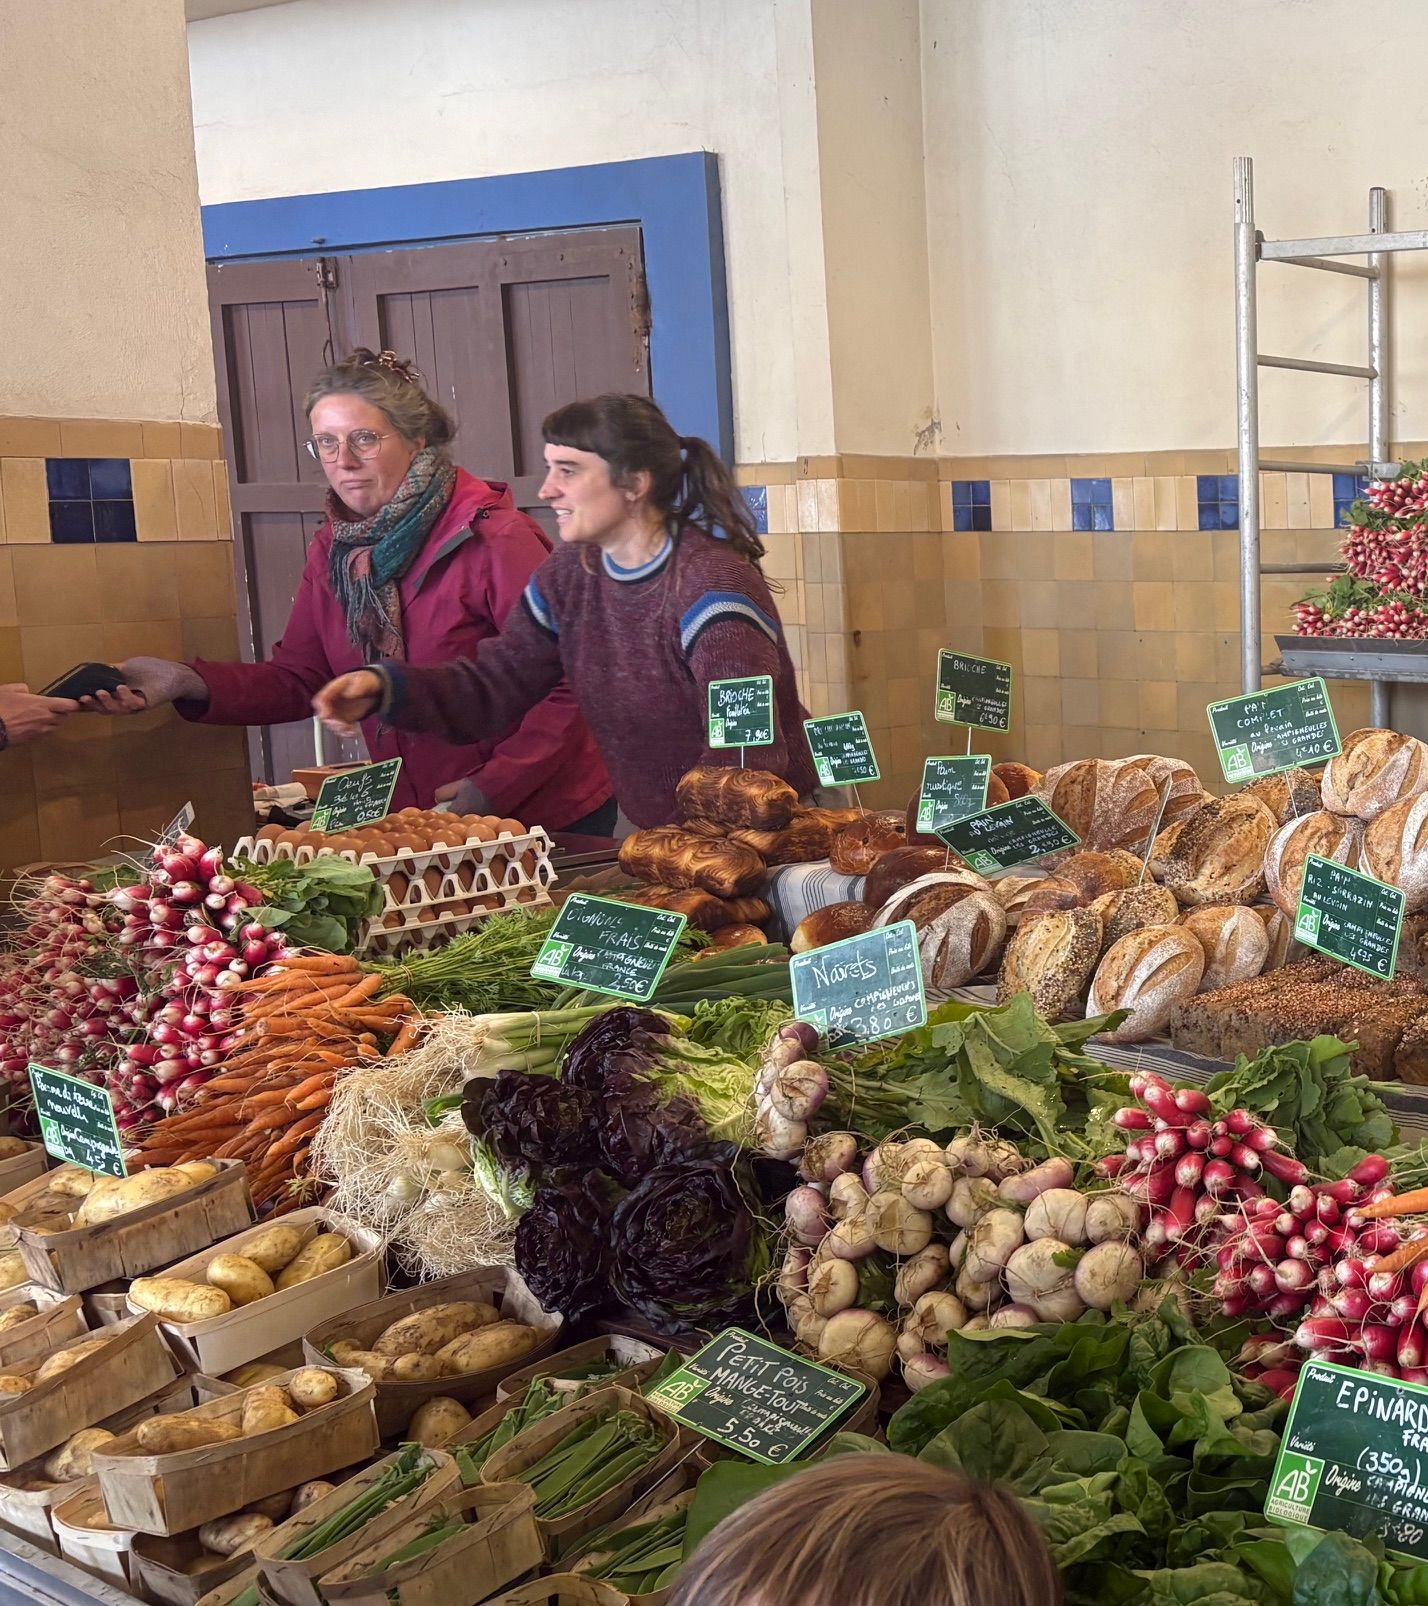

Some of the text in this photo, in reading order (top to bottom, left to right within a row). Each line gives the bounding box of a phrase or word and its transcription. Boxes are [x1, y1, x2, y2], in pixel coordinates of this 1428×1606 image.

[953, 659, 987, 675] BRIOCHE
[940, 698, 953, 711] AB
[1264, 721, 1293, 734] levain
[1323, 739, 1334, 753] €
[1228, 752, 1247, 771] AB
[1300, 914, 1316, 932] AB
[599, 927, 642, 950] FRAIS
[540, 949, 563, 966] AB
[1377, 959, 1388, 972] €
[905, 1005, 918, 1022] €
[113, 1162, 121, 1175] €
[716, 1342, 808, 1394] PETIT POIS
[1307, 1368, 1336, 1383] Produit
[660, 1381, 694, 1400] AB
[709, 1366, 808, 1414] MANGE-TOUT
[717, 1417, 789, 1457] 5,50 €
[1290, 1432, 1316, 1452] Variété
[1357, 1446, 1420, 1494] (350g)
[1276, 1469, 1311, 1502] AB
[1325, 1464, 1361, 1496] Origine
